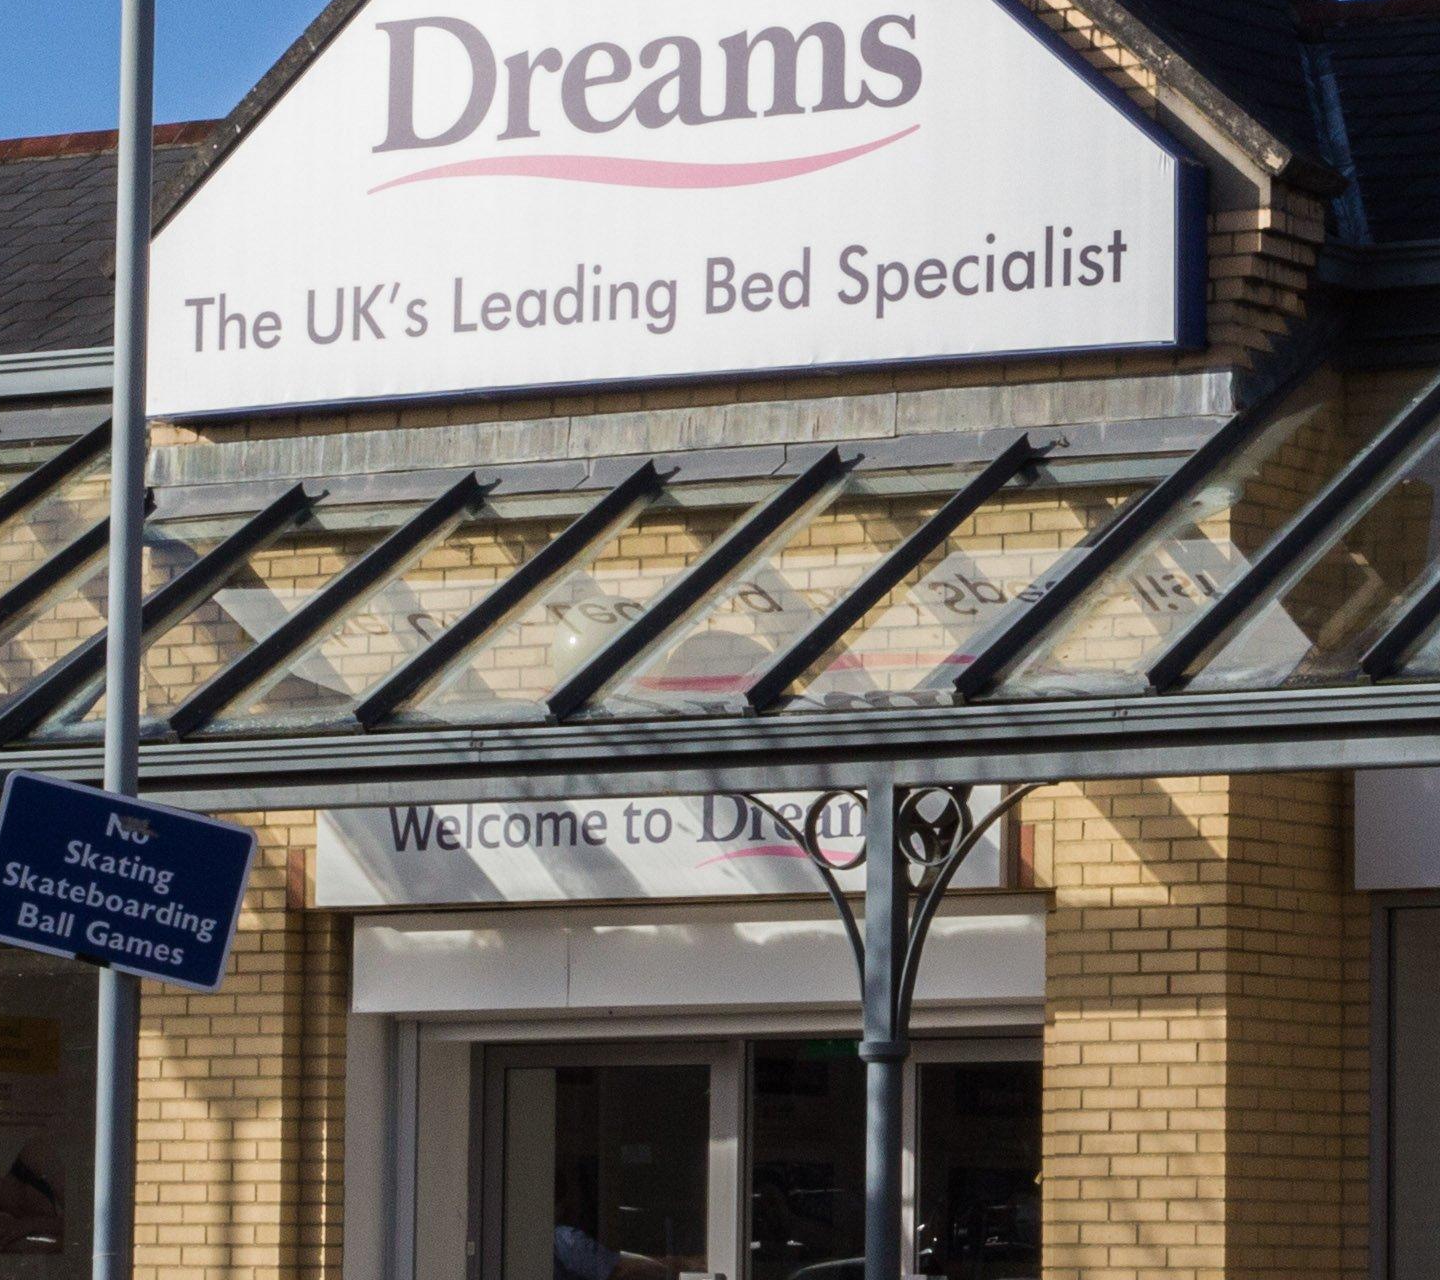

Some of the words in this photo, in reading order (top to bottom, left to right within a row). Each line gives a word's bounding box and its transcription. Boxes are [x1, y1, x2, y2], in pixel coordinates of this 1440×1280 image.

[371, 13, 923, 154] Dreams
[184, 297, 283, 354] The
[305, 283, 429, 343] UK's
[452, 262, 678, 334] Leading
[704, 246, 812, 315] Bed
[838, 226, 1128, 304] Specialist
[105, 812, 152, 845] No
[389, 804, 608, 852] Welcome
[625, 802, 672, 843] to
[696, 793, 867, 843] Dream
[64, 840, 176, 895] Skating
[2, 861, 219, 943] Skateboarding
[17, 902, 75, 939] Ball
[86, 920, 185, 966] Games
